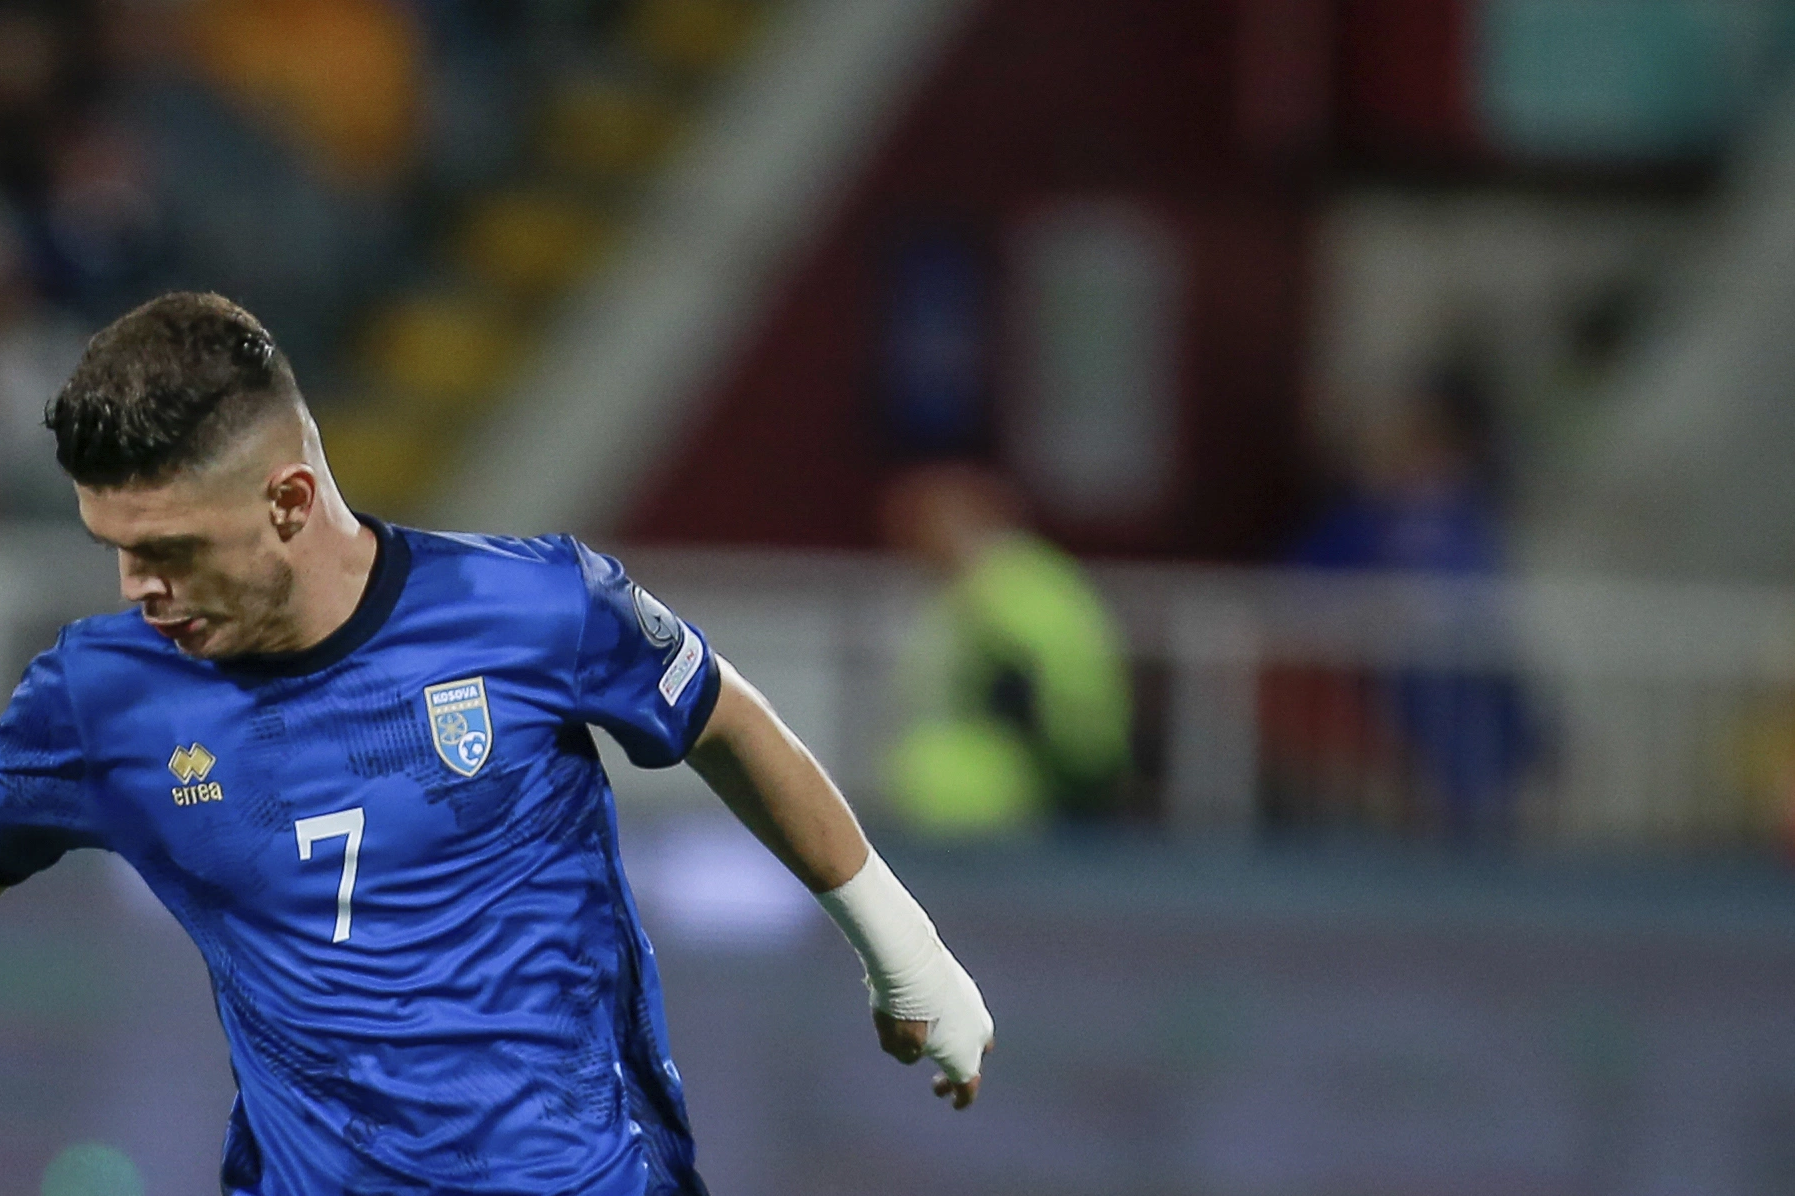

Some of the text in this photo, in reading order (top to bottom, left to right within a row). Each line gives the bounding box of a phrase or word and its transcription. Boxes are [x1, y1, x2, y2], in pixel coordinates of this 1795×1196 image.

[432, 685, 478, 704] KOSOVA
[172, 781, 224, 806] errea
[294, 807, 365, 943] 7
